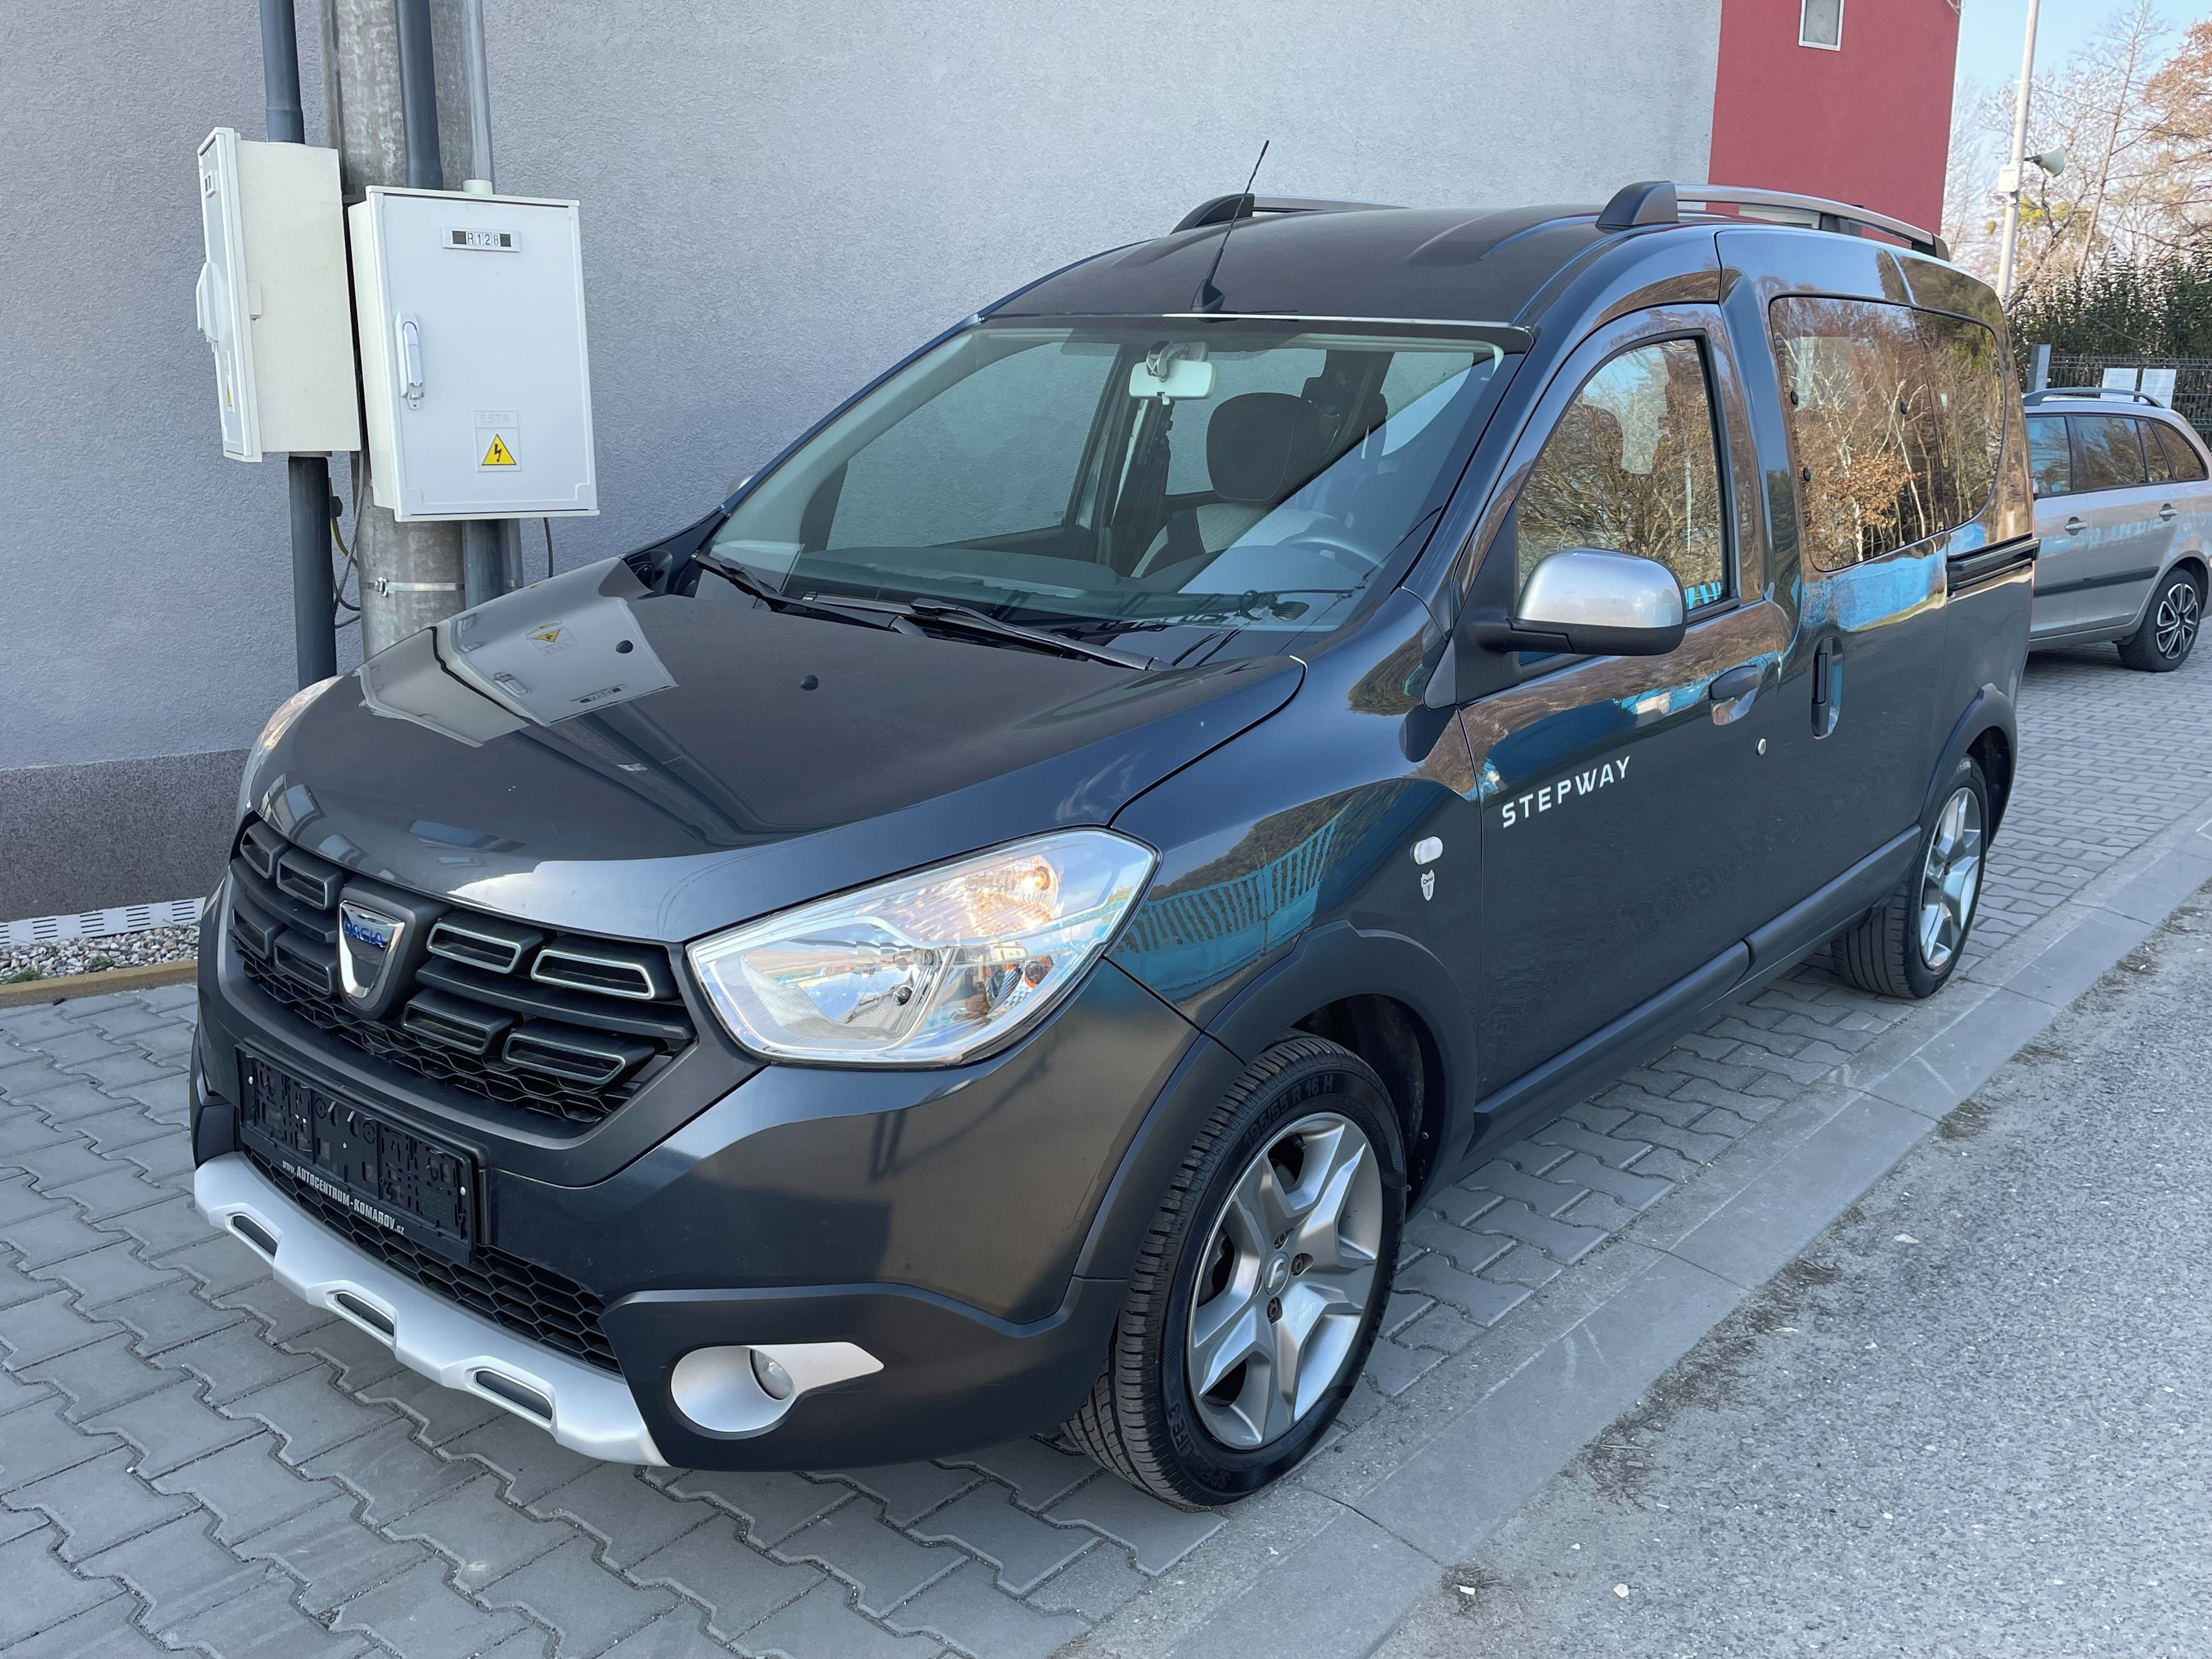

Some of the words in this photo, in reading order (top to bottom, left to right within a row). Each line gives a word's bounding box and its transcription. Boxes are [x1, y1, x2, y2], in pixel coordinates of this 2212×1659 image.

[467, 233, 499, 245] R128
[480, 414, 510, 424] ESTA
[1502, 755, 1630, 828] STEPWAY
[344, 920, 386, 949] DACIA
[1244, 1094, 1288, 1147] 195/55
[1293, 1085, 1302, 1102] R
[1305, 1078, 1319, 1097] 16
[1323, 1074, 1333, 1092] H
